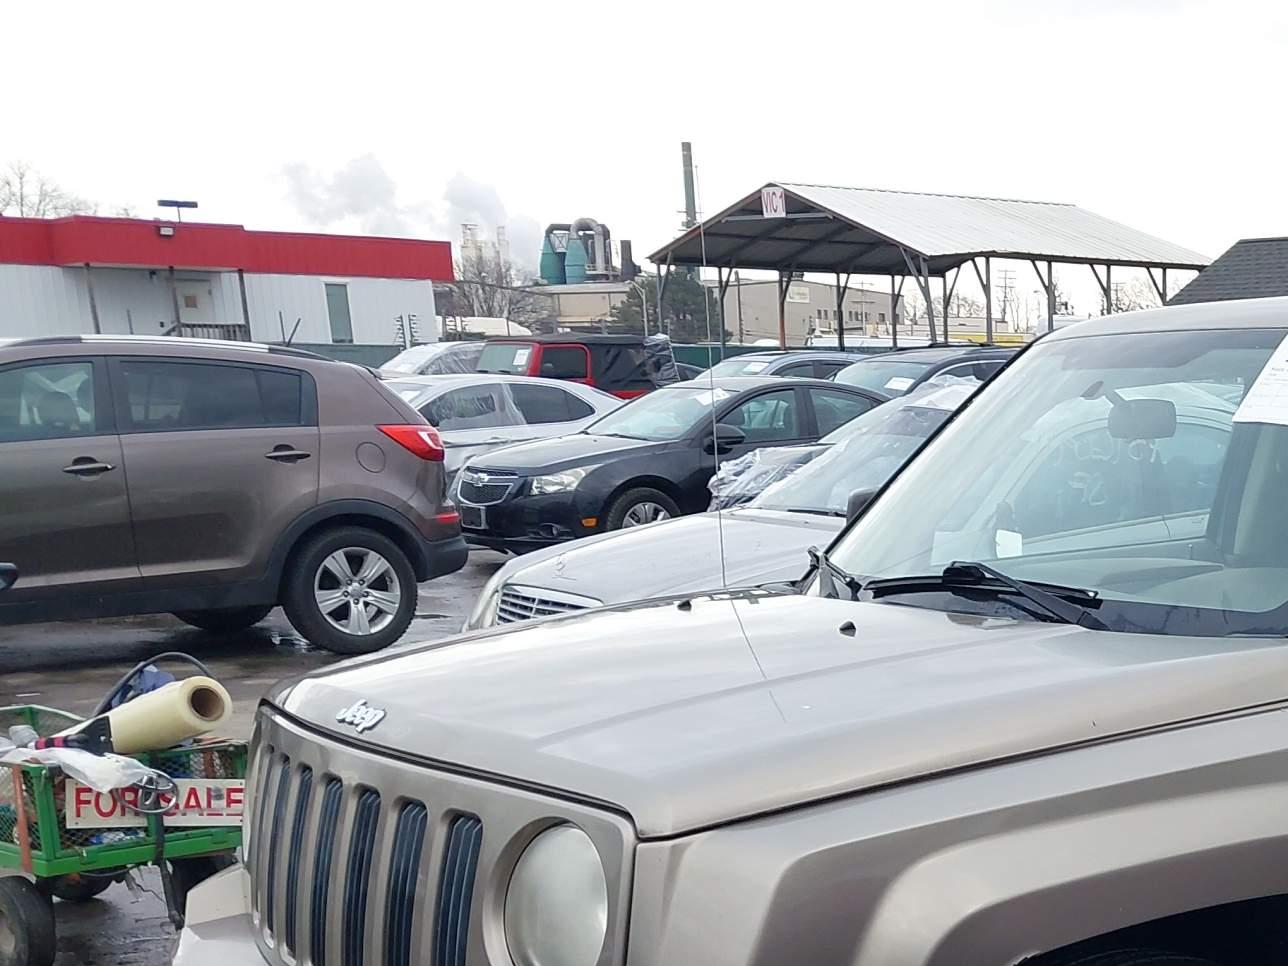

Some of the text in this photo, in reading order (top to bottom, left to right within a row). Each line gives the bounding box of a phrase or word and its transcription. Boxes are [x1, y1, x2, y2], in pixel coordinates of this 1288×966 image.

[762, 191, 778, 214] VIC
[335, 699, 386, 733] Jeep
[75, 786, 141, 818] FOR
